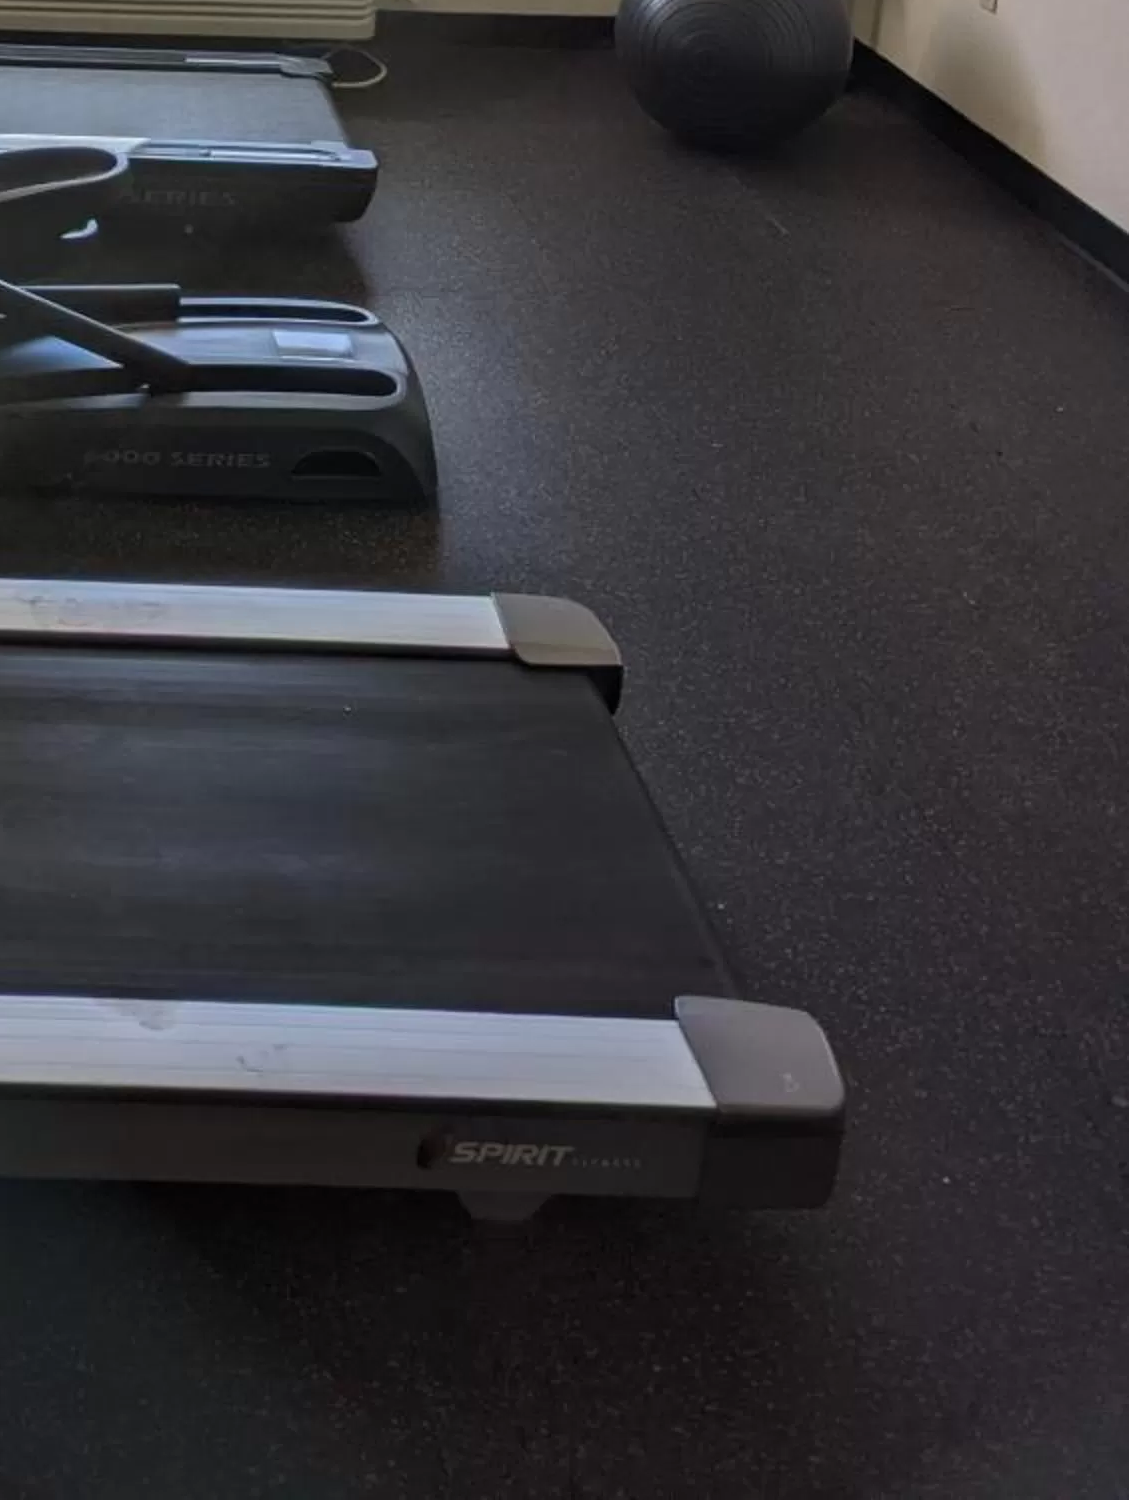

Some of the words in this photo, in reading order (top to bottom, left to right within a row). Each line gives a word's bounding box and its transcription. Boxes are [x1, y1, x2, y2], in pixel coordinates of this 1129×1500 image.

[125, 190, 236, 207] ERIES
[170, 452, 272, 469] SERIES
[449, 1140, 577, 1168] SPIRIT
